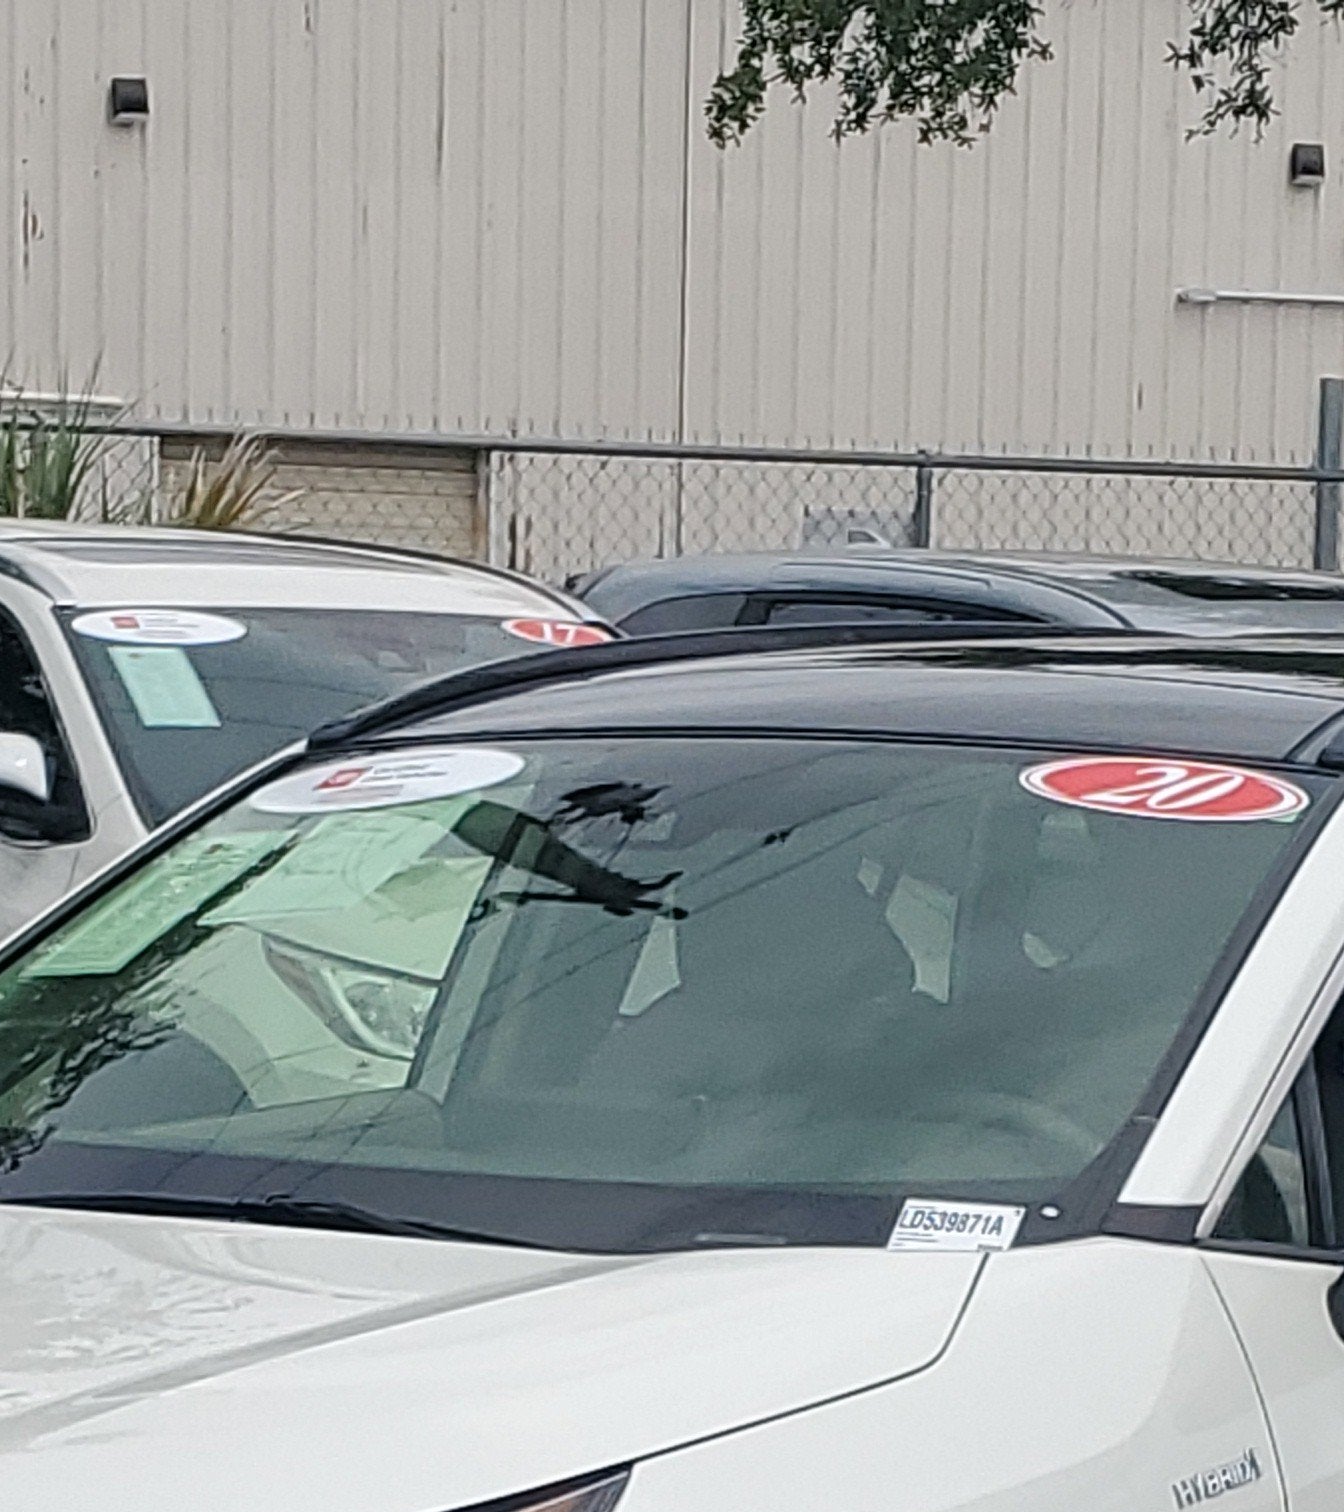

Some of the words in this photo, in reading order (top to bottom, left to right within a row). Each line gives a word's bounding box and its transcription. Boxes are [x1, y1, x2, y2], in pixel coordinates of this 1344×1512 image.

[542, 622, 577, 644] 17
[1077, 765, 1247, 810] 20
[1171, 1450, 1260, 1510] HYBRID
